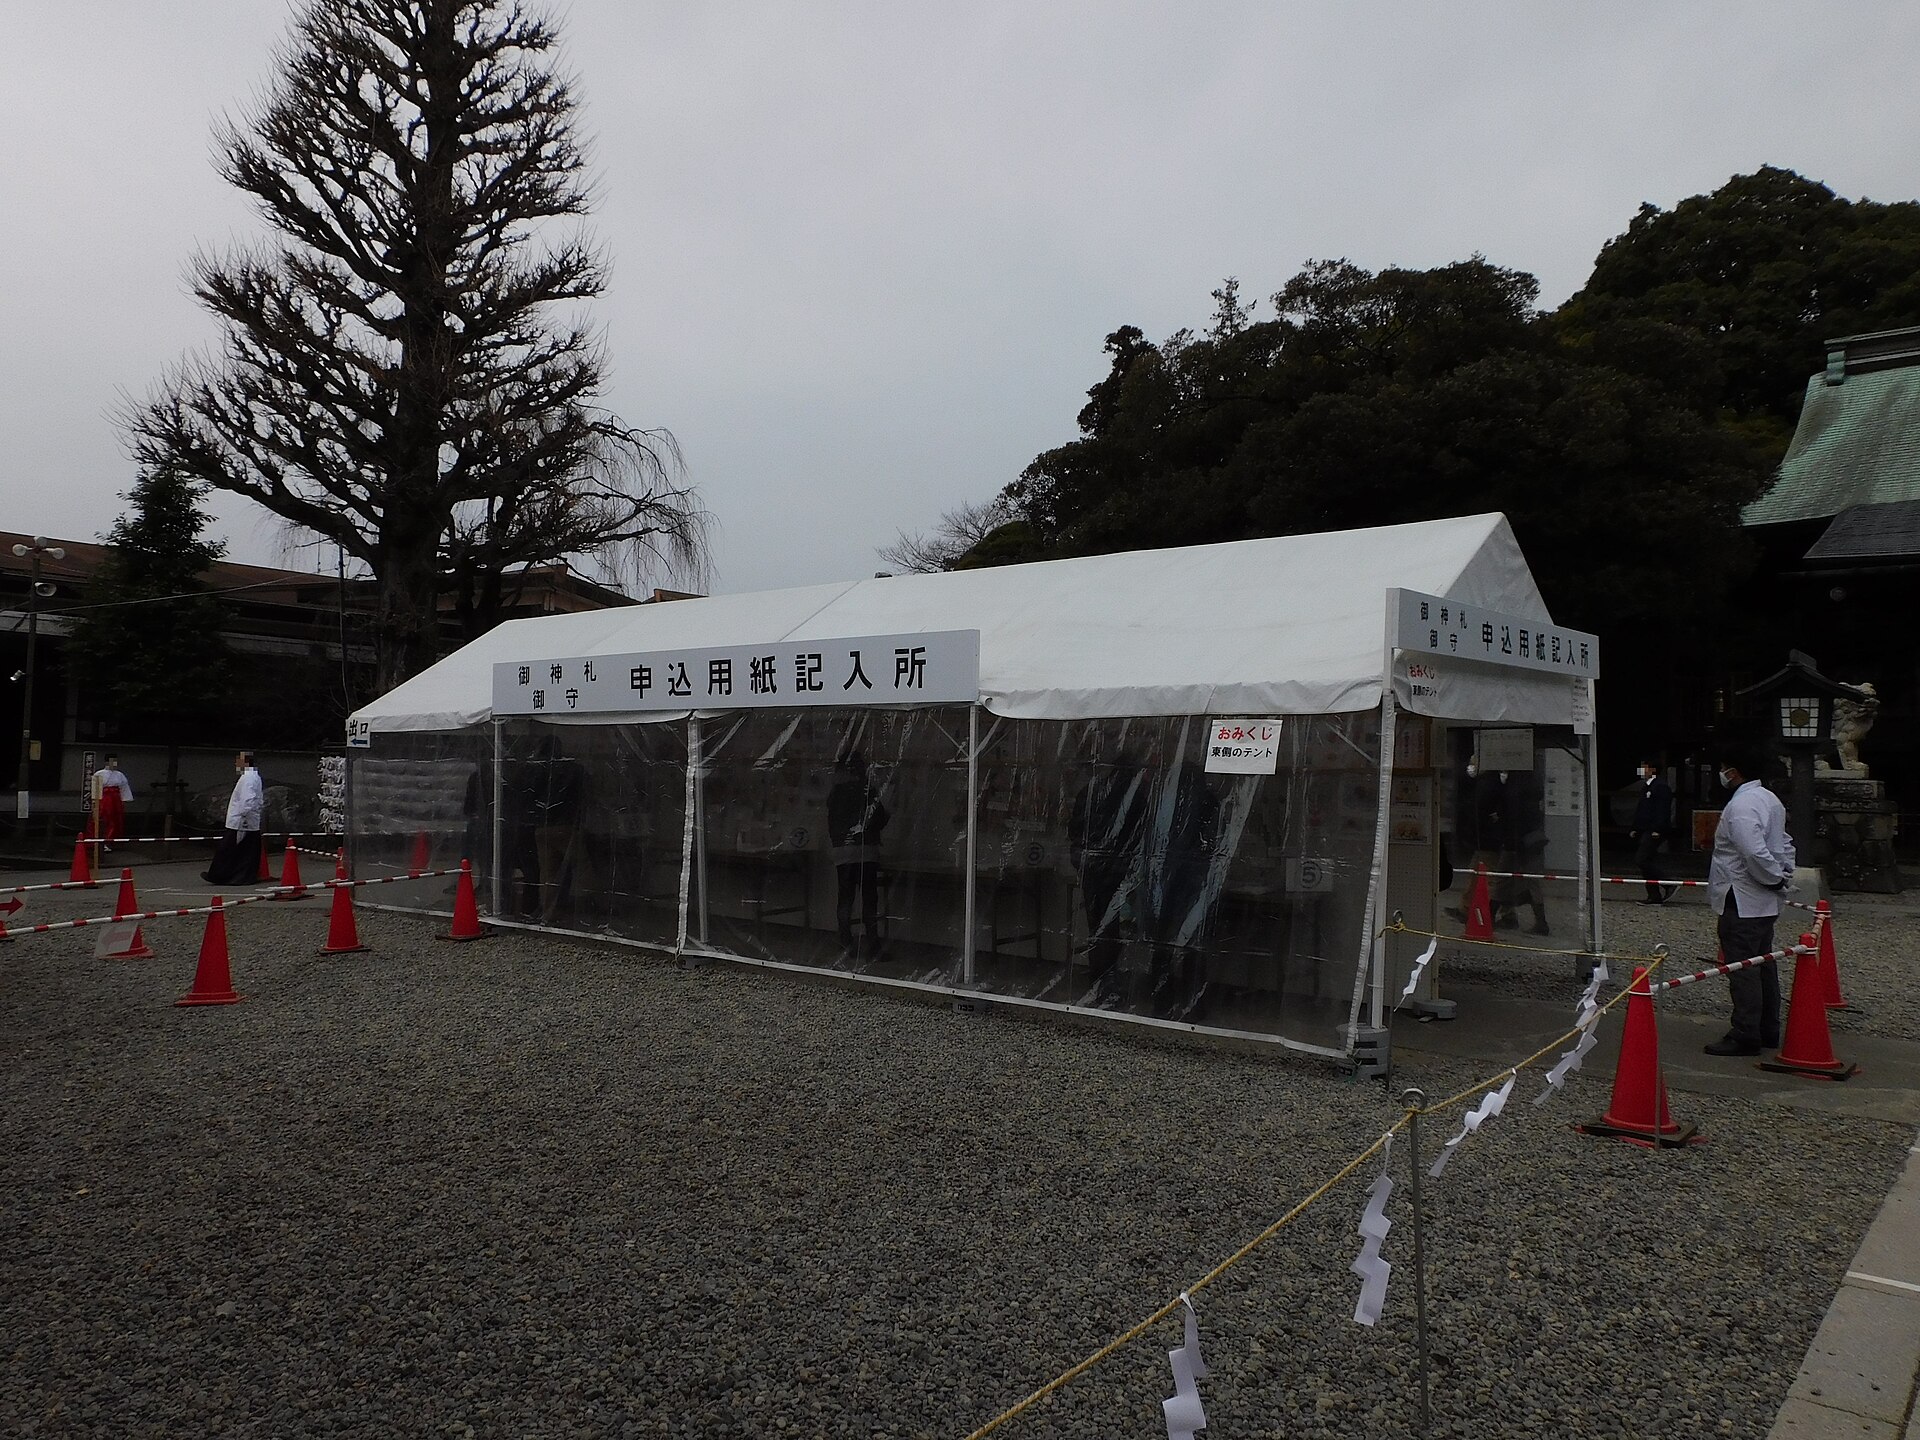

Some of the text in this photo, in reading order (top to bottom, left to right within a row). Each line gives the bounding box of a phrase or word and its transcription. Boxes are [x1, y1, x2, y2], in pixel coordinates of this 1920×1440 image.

[1482, 621, 1589, 669] 申込用紙記入所
[518, 660, 597, 686] 御神札
[630, 647, 926, 699] 申込用紙記入所
[1409, 664, 1435, 680] おみくじ
[532, 687, 579, 710] 御守
[348, 719, 369, 737] 出口
[1217, 726, 1273, 741] おみくじ
[1211, 746, 1272, 758] 東側のテント
